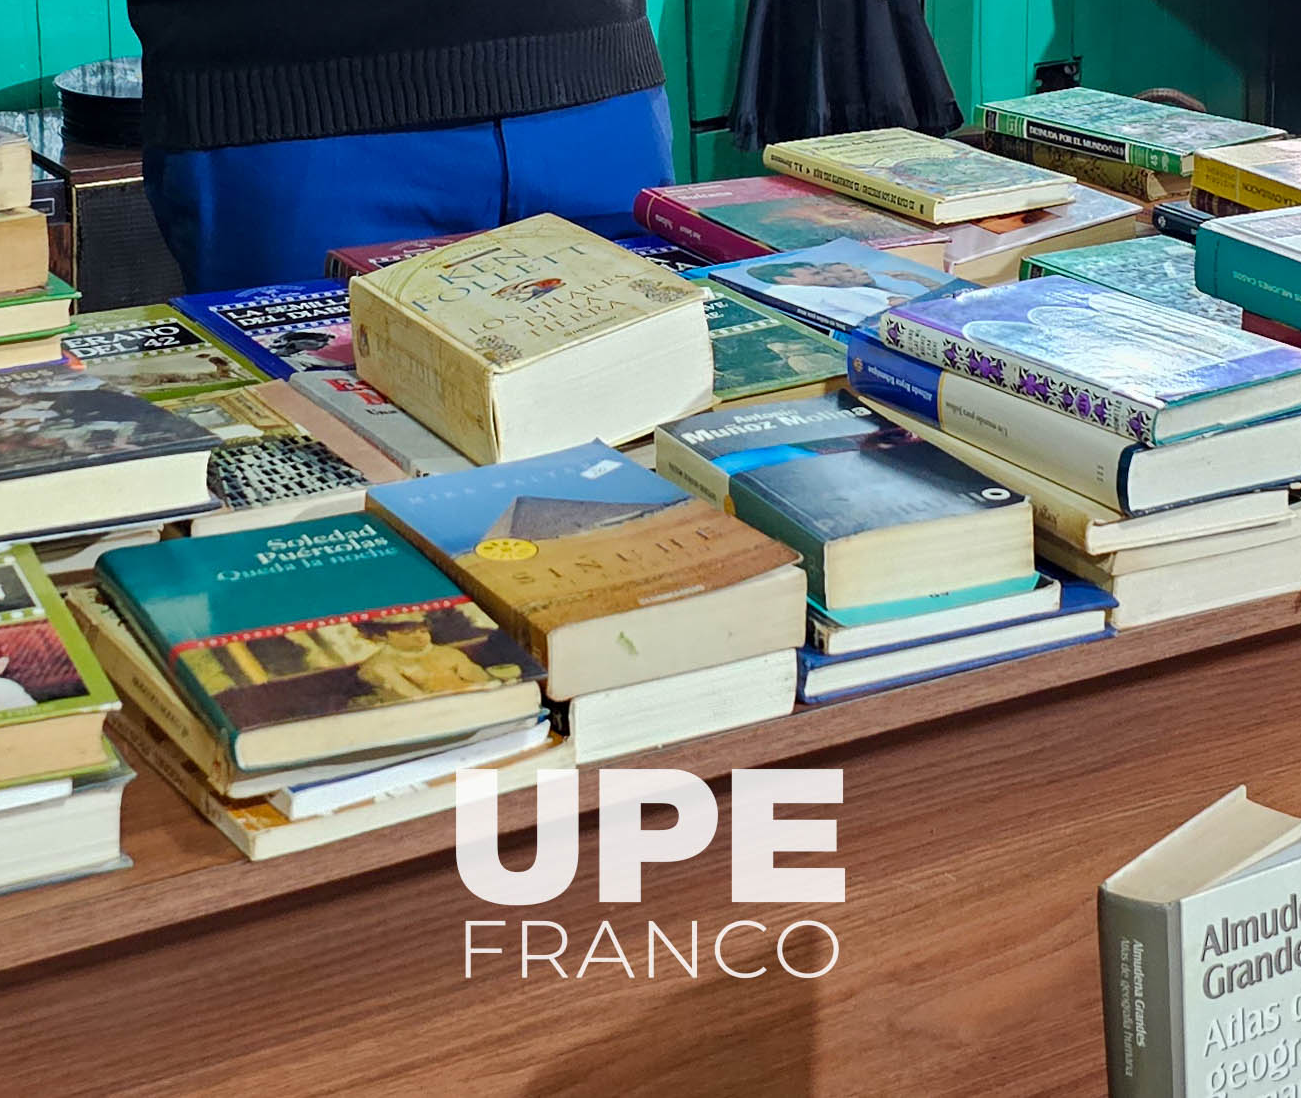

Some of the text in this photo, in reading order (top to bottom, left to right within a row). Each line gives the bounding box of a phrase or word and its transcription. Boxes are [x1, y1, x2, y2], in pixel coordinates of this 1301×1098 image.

[437, 249, 529, 285] KEN
[227, 310, 263, 320] LA
[237, 305, 351, 327] DEL DIAB
[468, 314, 520, 336] LOS
[64, 324, 181, 350] ERANO
[74, 335, 181, 361] DEL 42
[680, 405, 873, 446] Muñoz Molina
[733, 408, 800, 425] Antonio
[256, 536, 389, 565] Puértolas
[266, 523, 378, 551] Soledad
[217, 545, 399, 582] Queda la noche
[1132, 937, 1148, 1048] Almudena Grandes
[1204, 1005, 1283, 1059] Atlas
